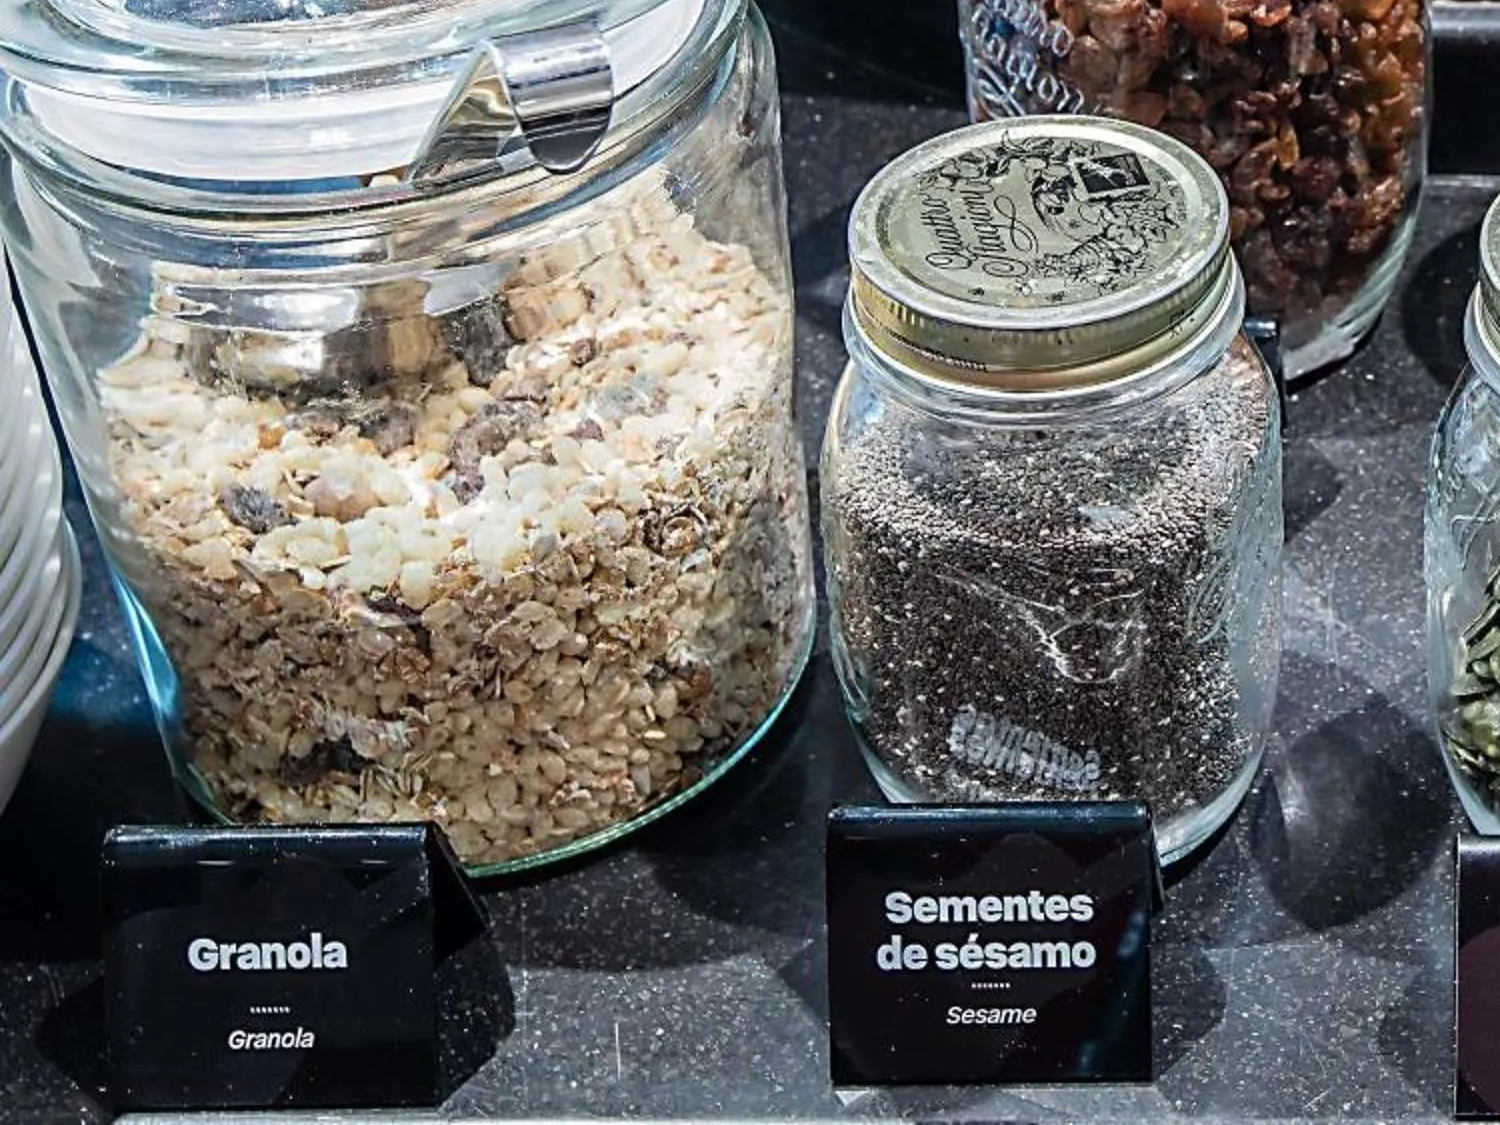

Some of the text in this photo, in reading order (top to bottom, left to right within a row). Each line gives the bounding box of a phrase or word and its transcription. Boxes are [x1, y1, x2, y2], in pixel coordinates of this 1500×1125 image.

[885, 890, 1094, 924] Sementes
[187, 932, 348, 971] Granola
[876, 932, 1097, 970] de sésamo
[946, 1006, 1038, 1024] Sesame
[228, 1026, 315, 1050] Granola
